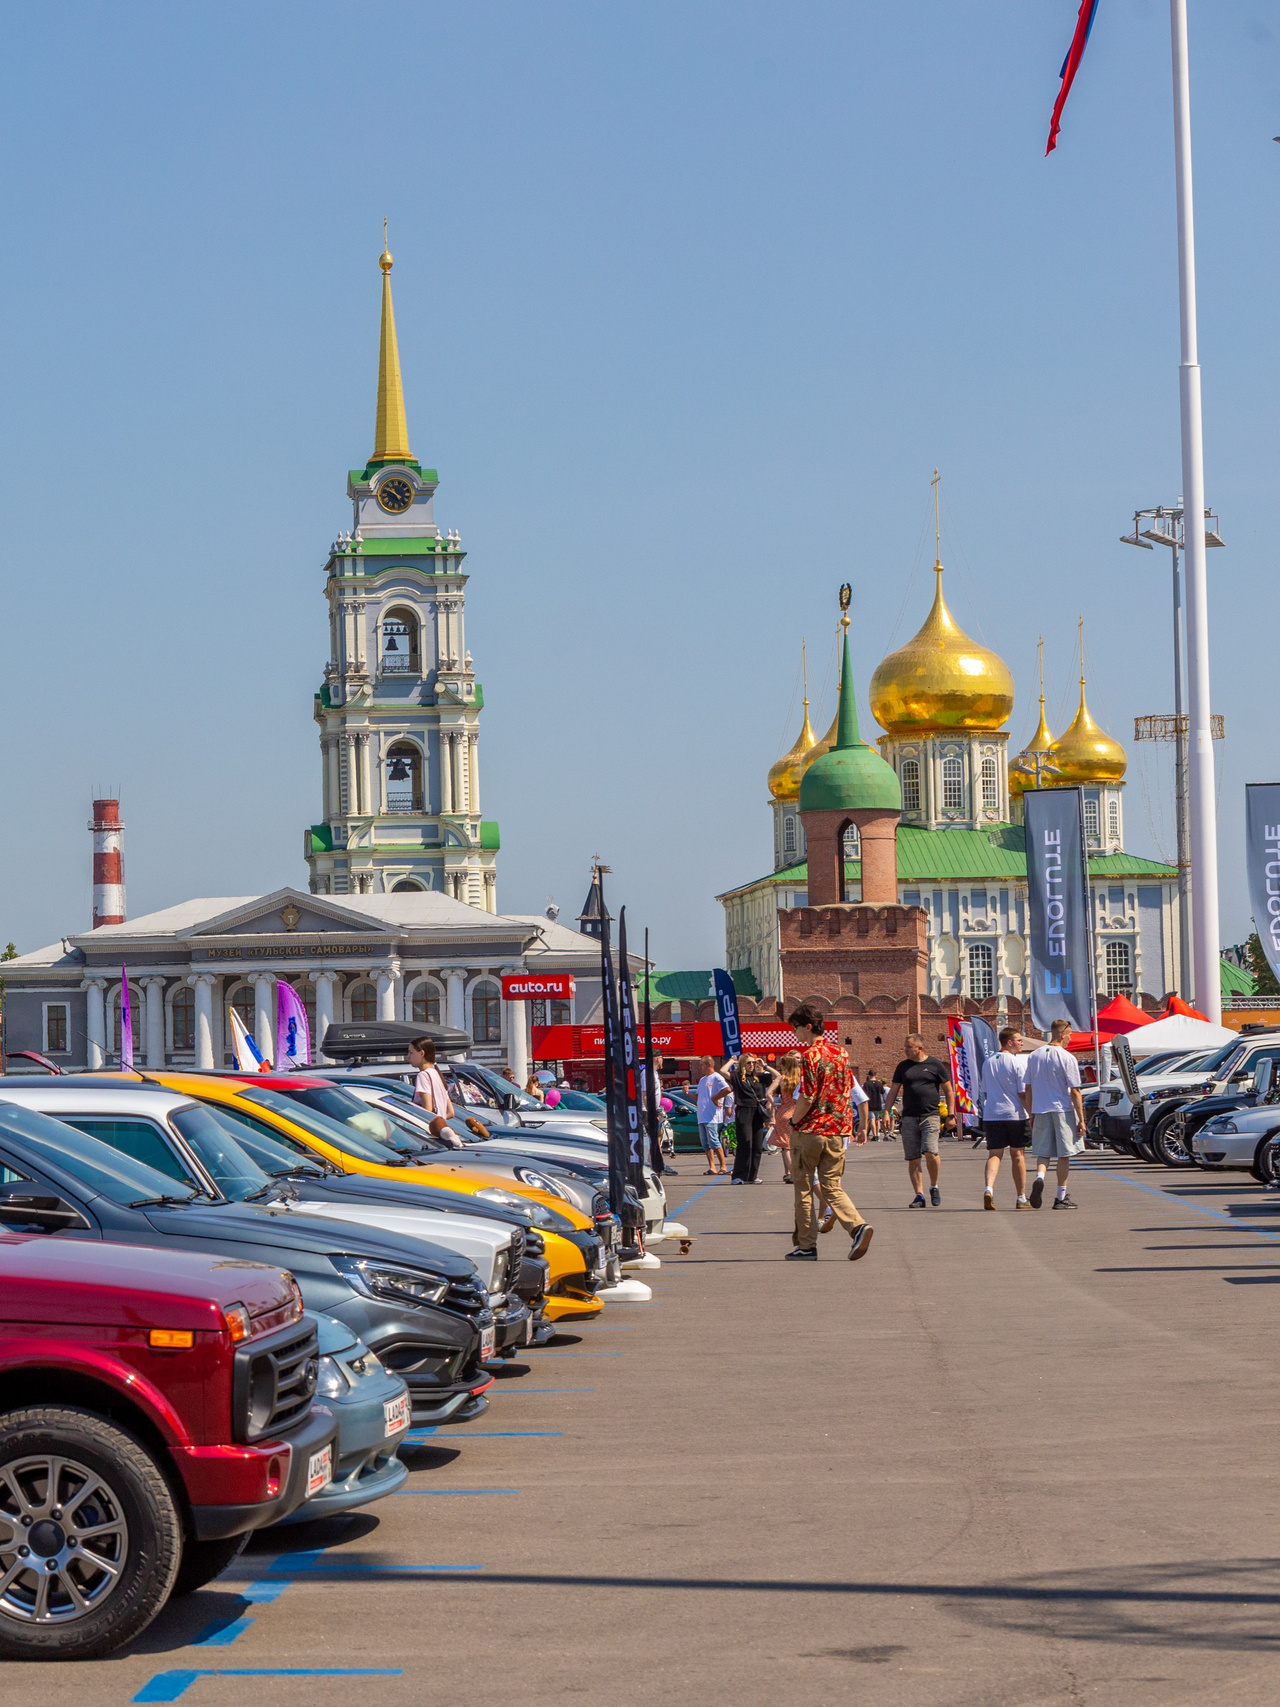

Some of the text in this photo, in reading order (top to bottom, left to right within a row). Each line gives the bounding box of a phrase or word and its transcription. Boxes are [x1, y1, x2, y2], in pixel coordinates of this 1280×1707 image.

[208, 944, 374, 958] МУЗЕЙ «ТУЛЬСКИЕ САМОВАРЫ»
[509, 981, 563, 994] auto.ru
